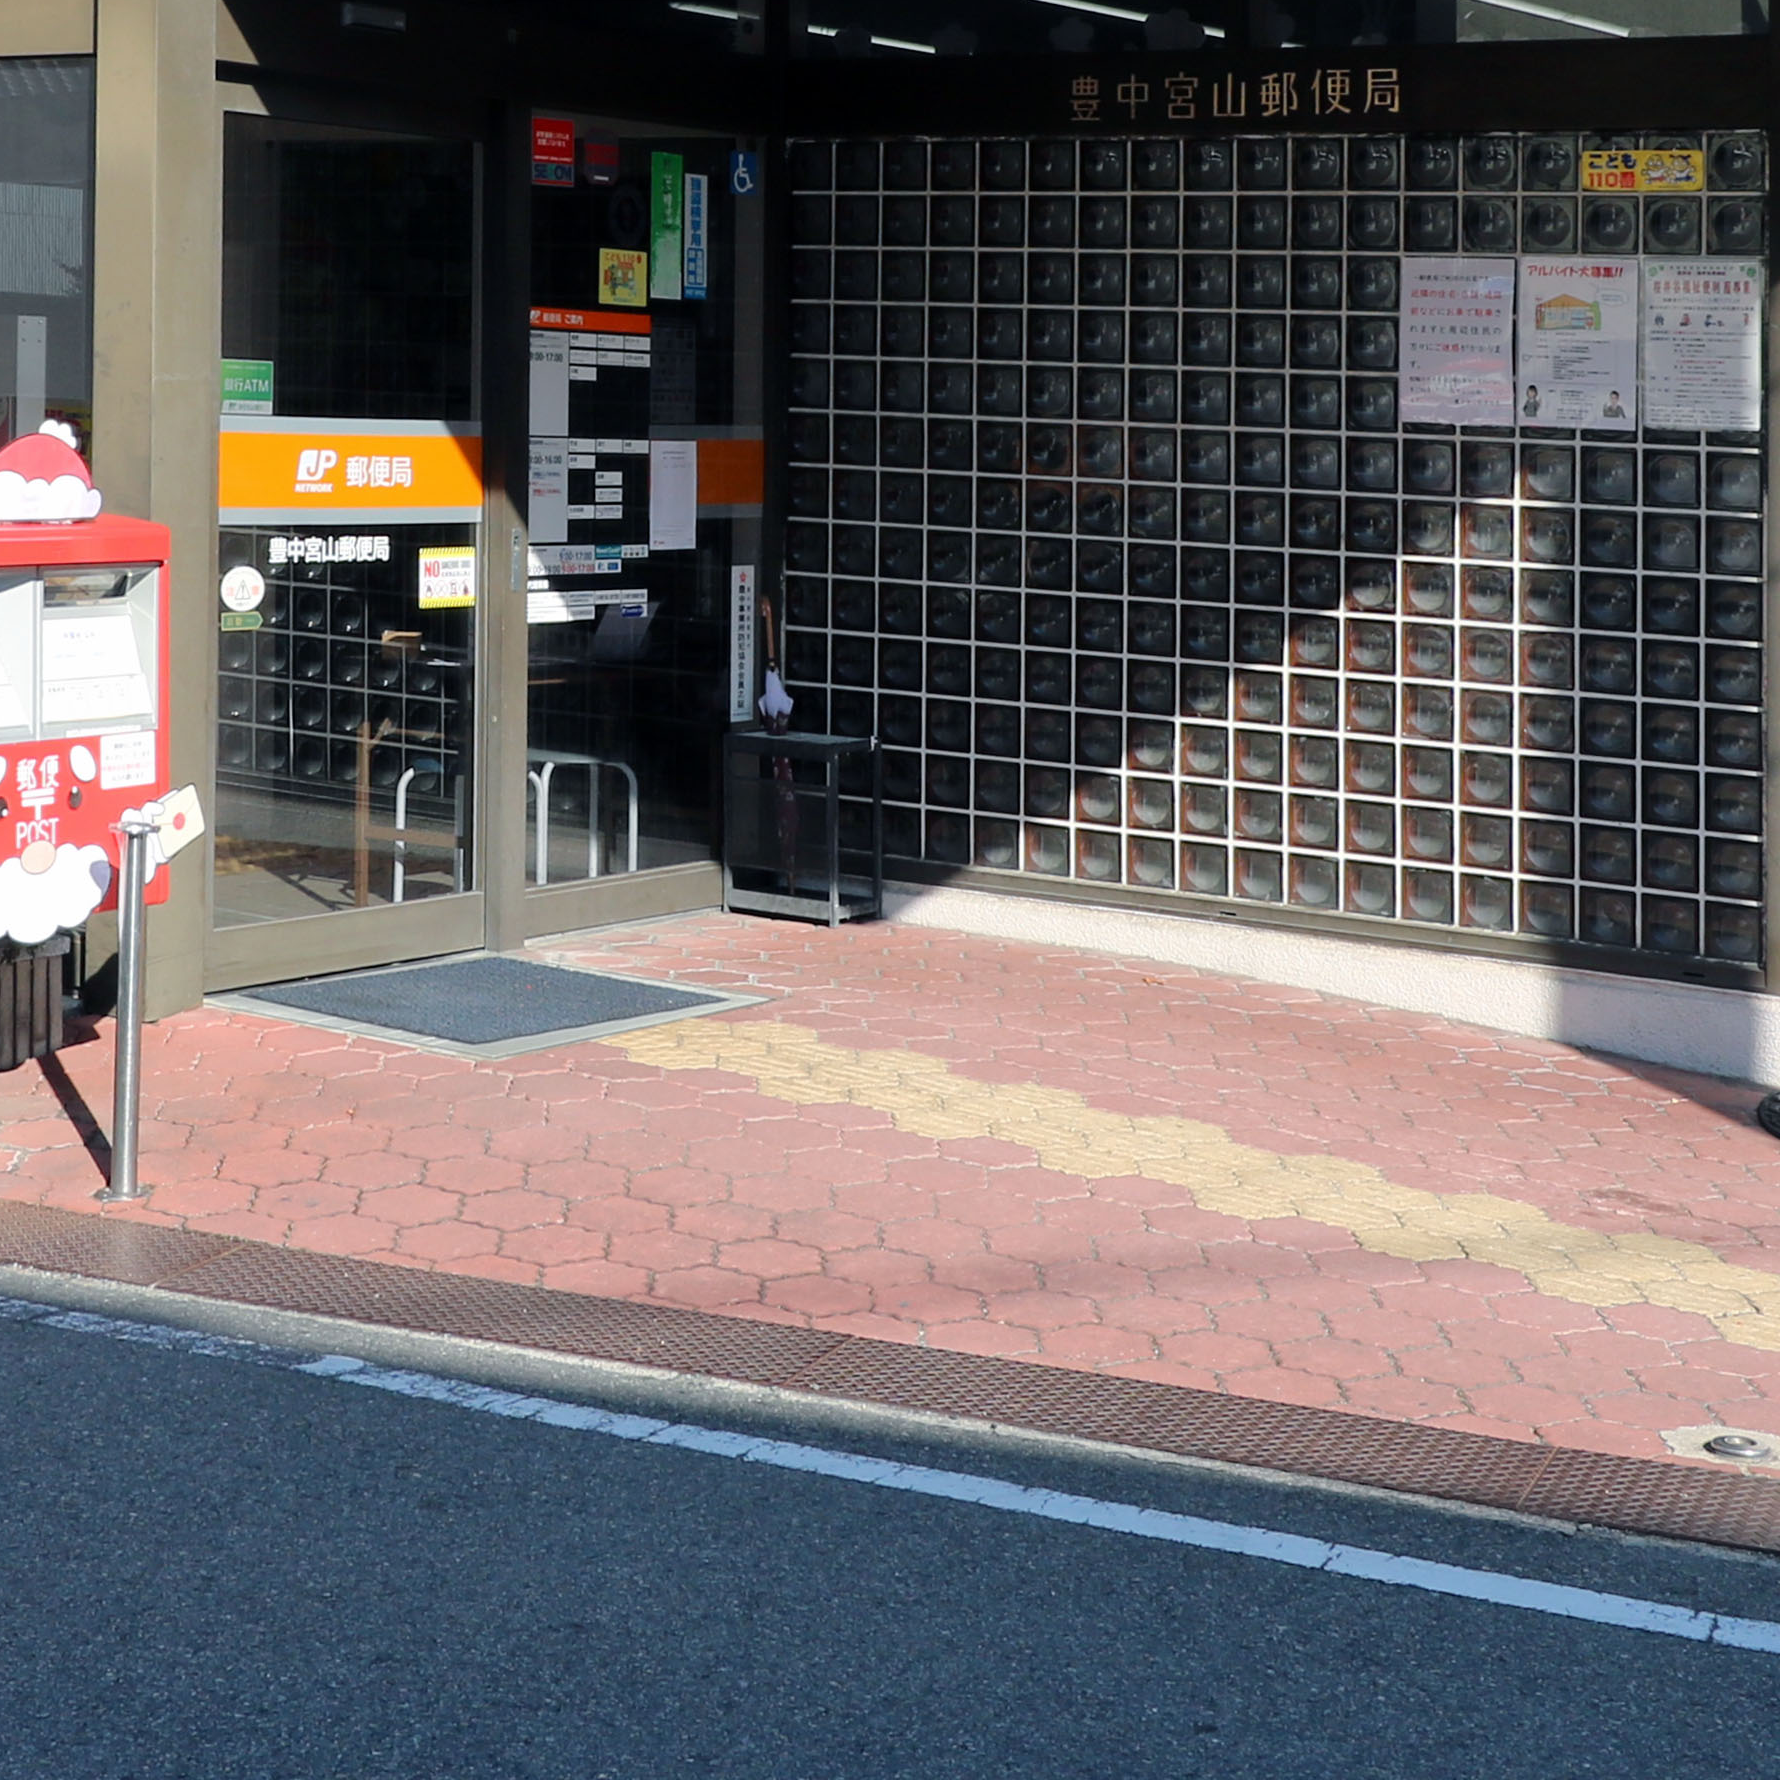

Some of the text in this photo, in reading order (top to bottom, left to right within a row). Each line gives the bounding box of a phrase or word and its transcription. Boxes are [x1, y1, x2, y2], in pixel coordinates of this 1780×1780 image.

[1070, 68, 1401, 121] 豊中宮山郵便局
[1588, 153, 1637, 170] こども
[1588, 171, 1636, 189] 110番
[296, 449, 412, 488] JP 郵便局
[294, 482, 333, 493] NETWORK
[269, 535, 391, 564] 豊中宮山郵便局
[424, 560, 441, 578] NO
[16, 754, 60, 791] 郵便
[16, 818, 60, 849] POST
